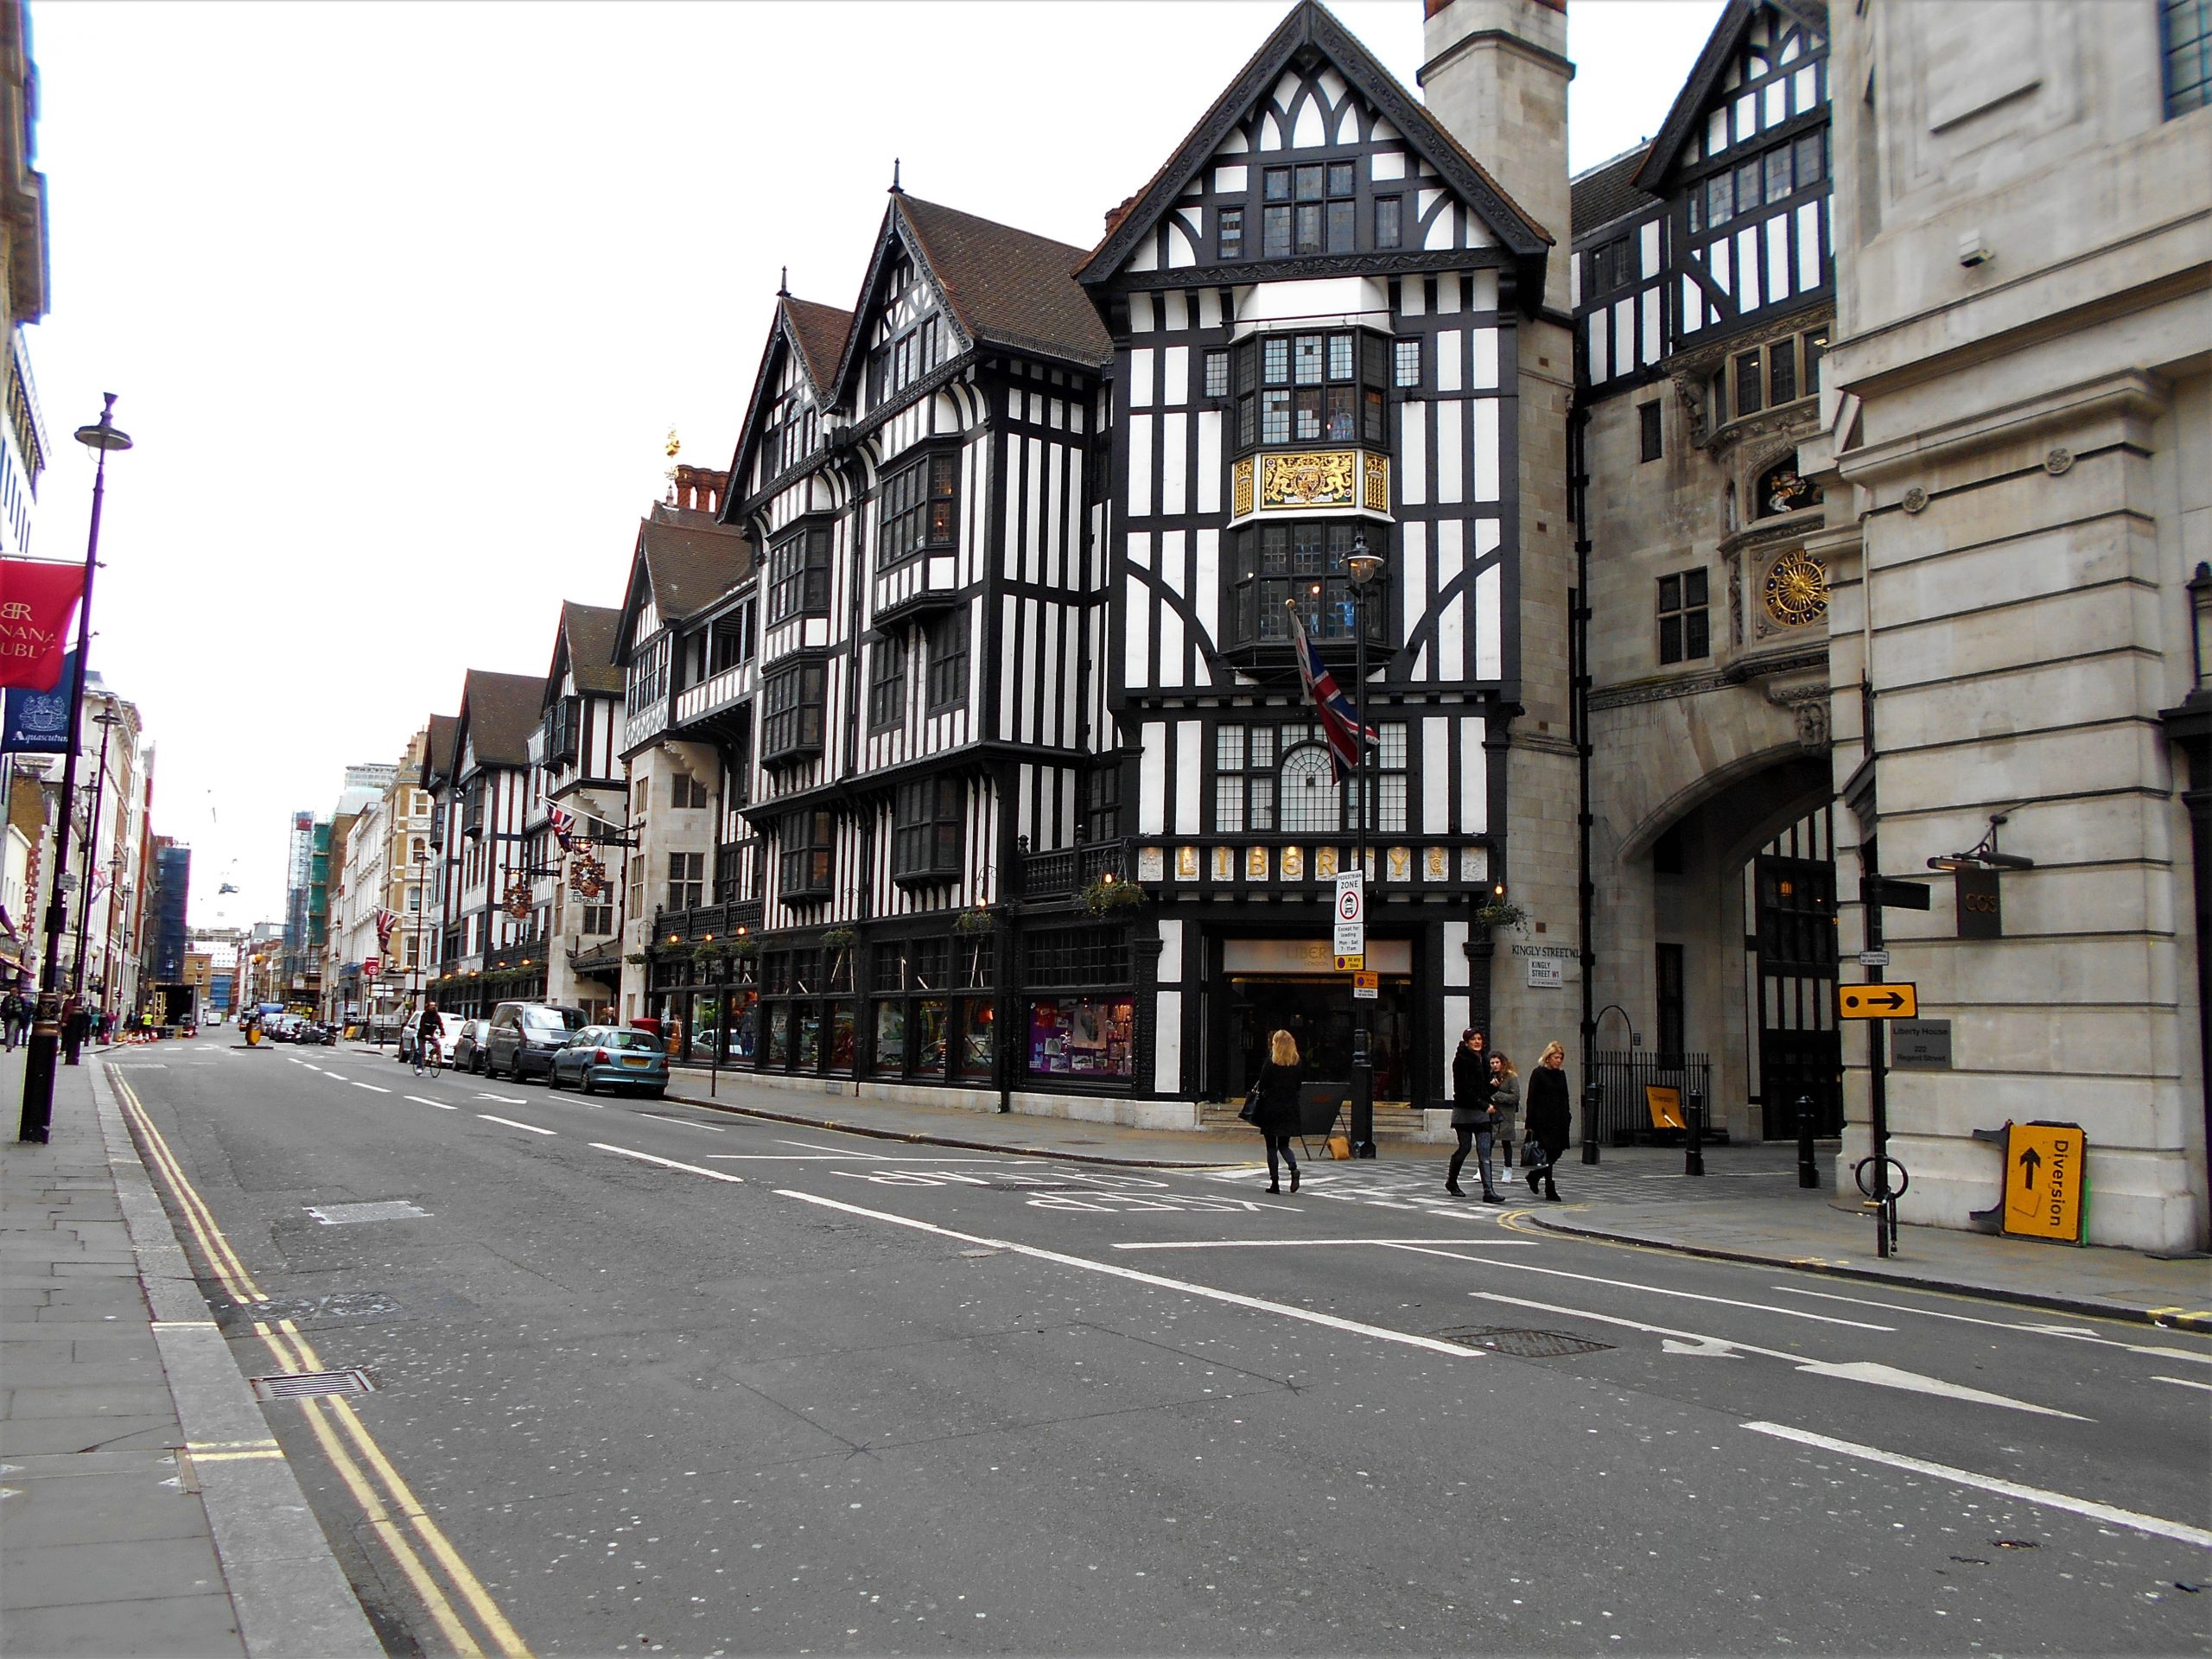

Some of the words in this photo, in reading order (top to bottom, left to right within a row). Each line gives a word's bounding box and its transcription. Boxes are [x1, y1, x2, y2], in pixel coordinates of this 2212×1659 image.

[1340, 880, 1359, 889] ZONE
[1965, 893, 1997, 913] COS
[1511, 944, 1541, 957] KINGLY
[1542, 946, 1569, 957] STREET
[1531, 961, 1551, 969] KINGLY
[1531, 969, 1551, 978] STREET
[1893, 1027, 1920, 1036] Liberty
[1897, 1053, 1923, 1062] Regent
[2050, 1139, 2069, 1227] Diversion
